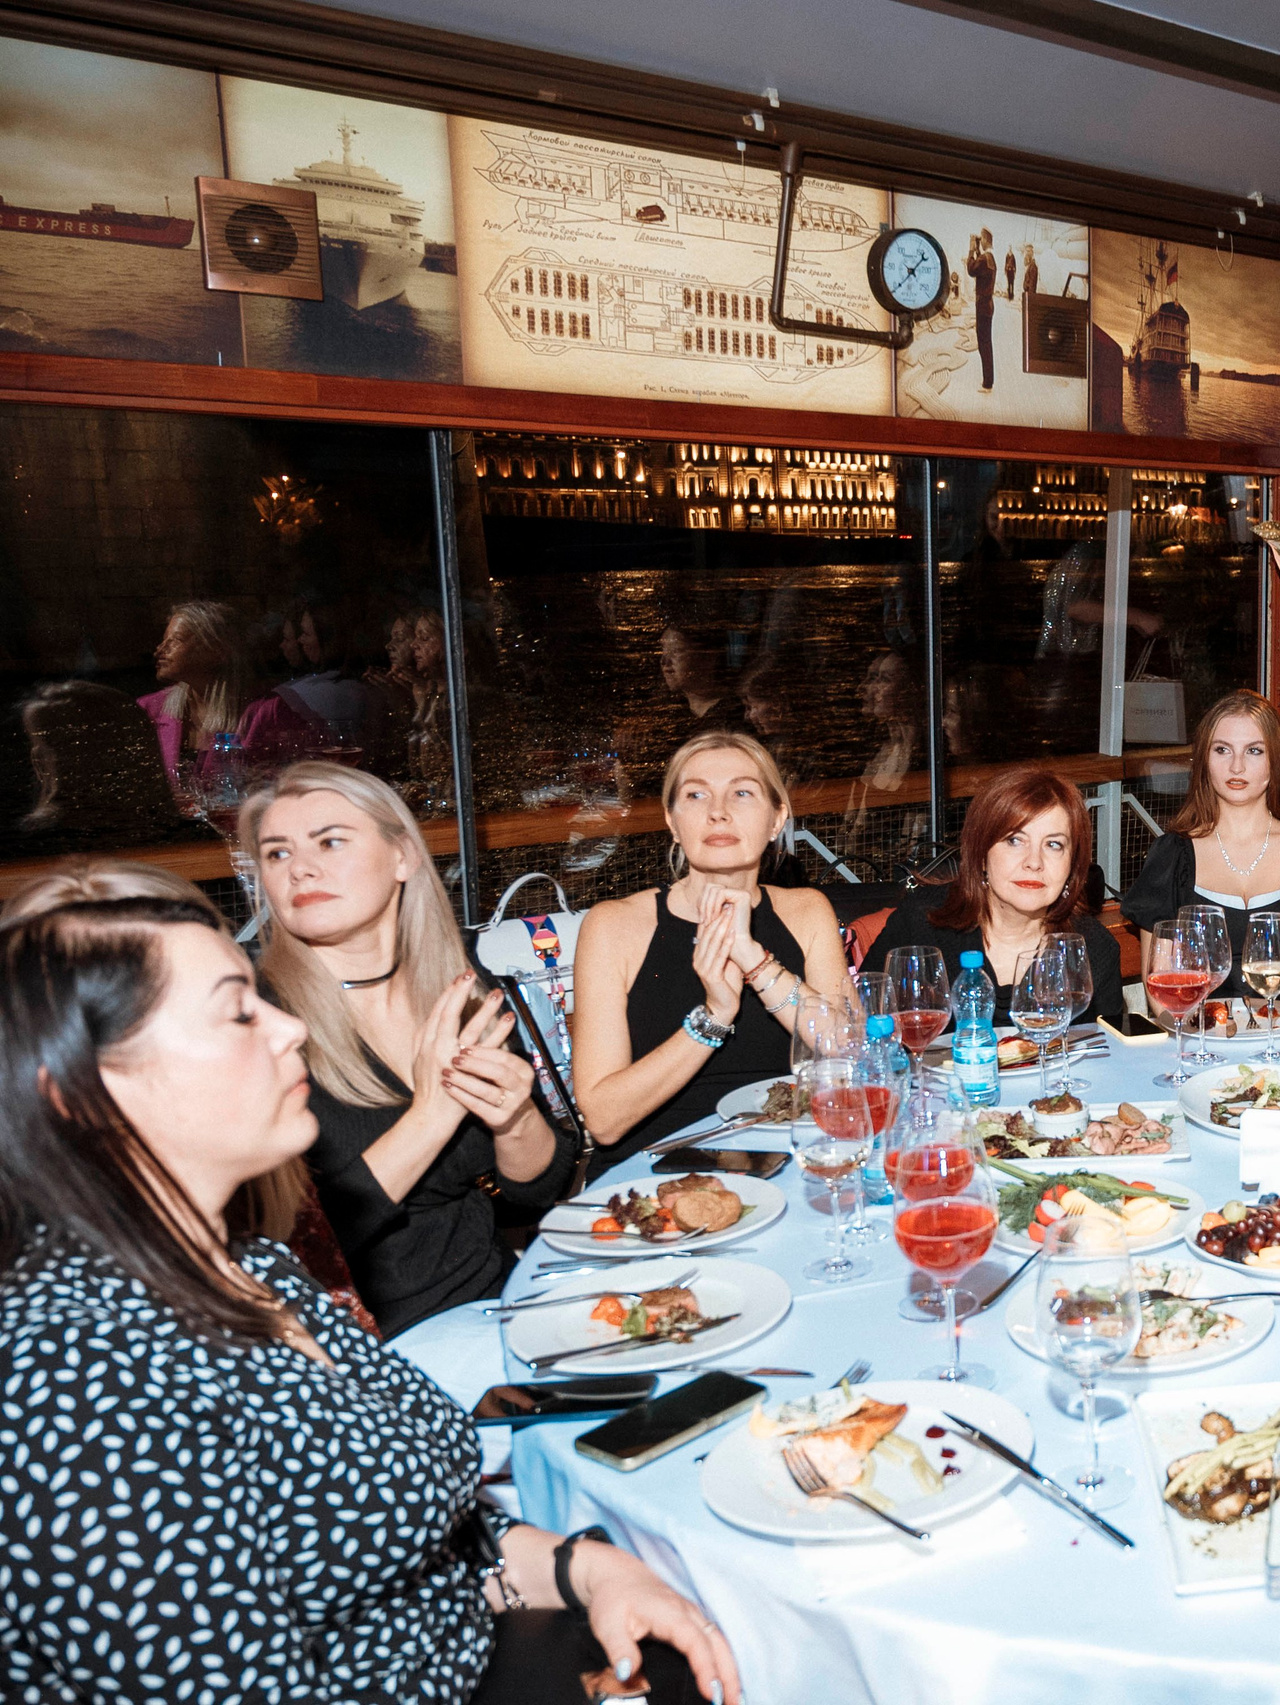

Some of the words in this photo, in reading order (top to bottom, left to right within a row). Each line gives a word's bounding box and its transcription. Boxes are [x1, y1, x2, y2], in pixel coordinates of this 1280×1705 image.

[527, 130, 570, 147] Кормовой
[573, 143, 636, 160] пассажирский
[637, 154, 662, 164] салон
[18, 215, 112, 236] EXPRESS
[483, 219, 502, 230] Руль
[517, 224, 549, 238] Заднее
[638, 232, 684, 246] Двигатель
[578, 255, 616, 268] Средний
